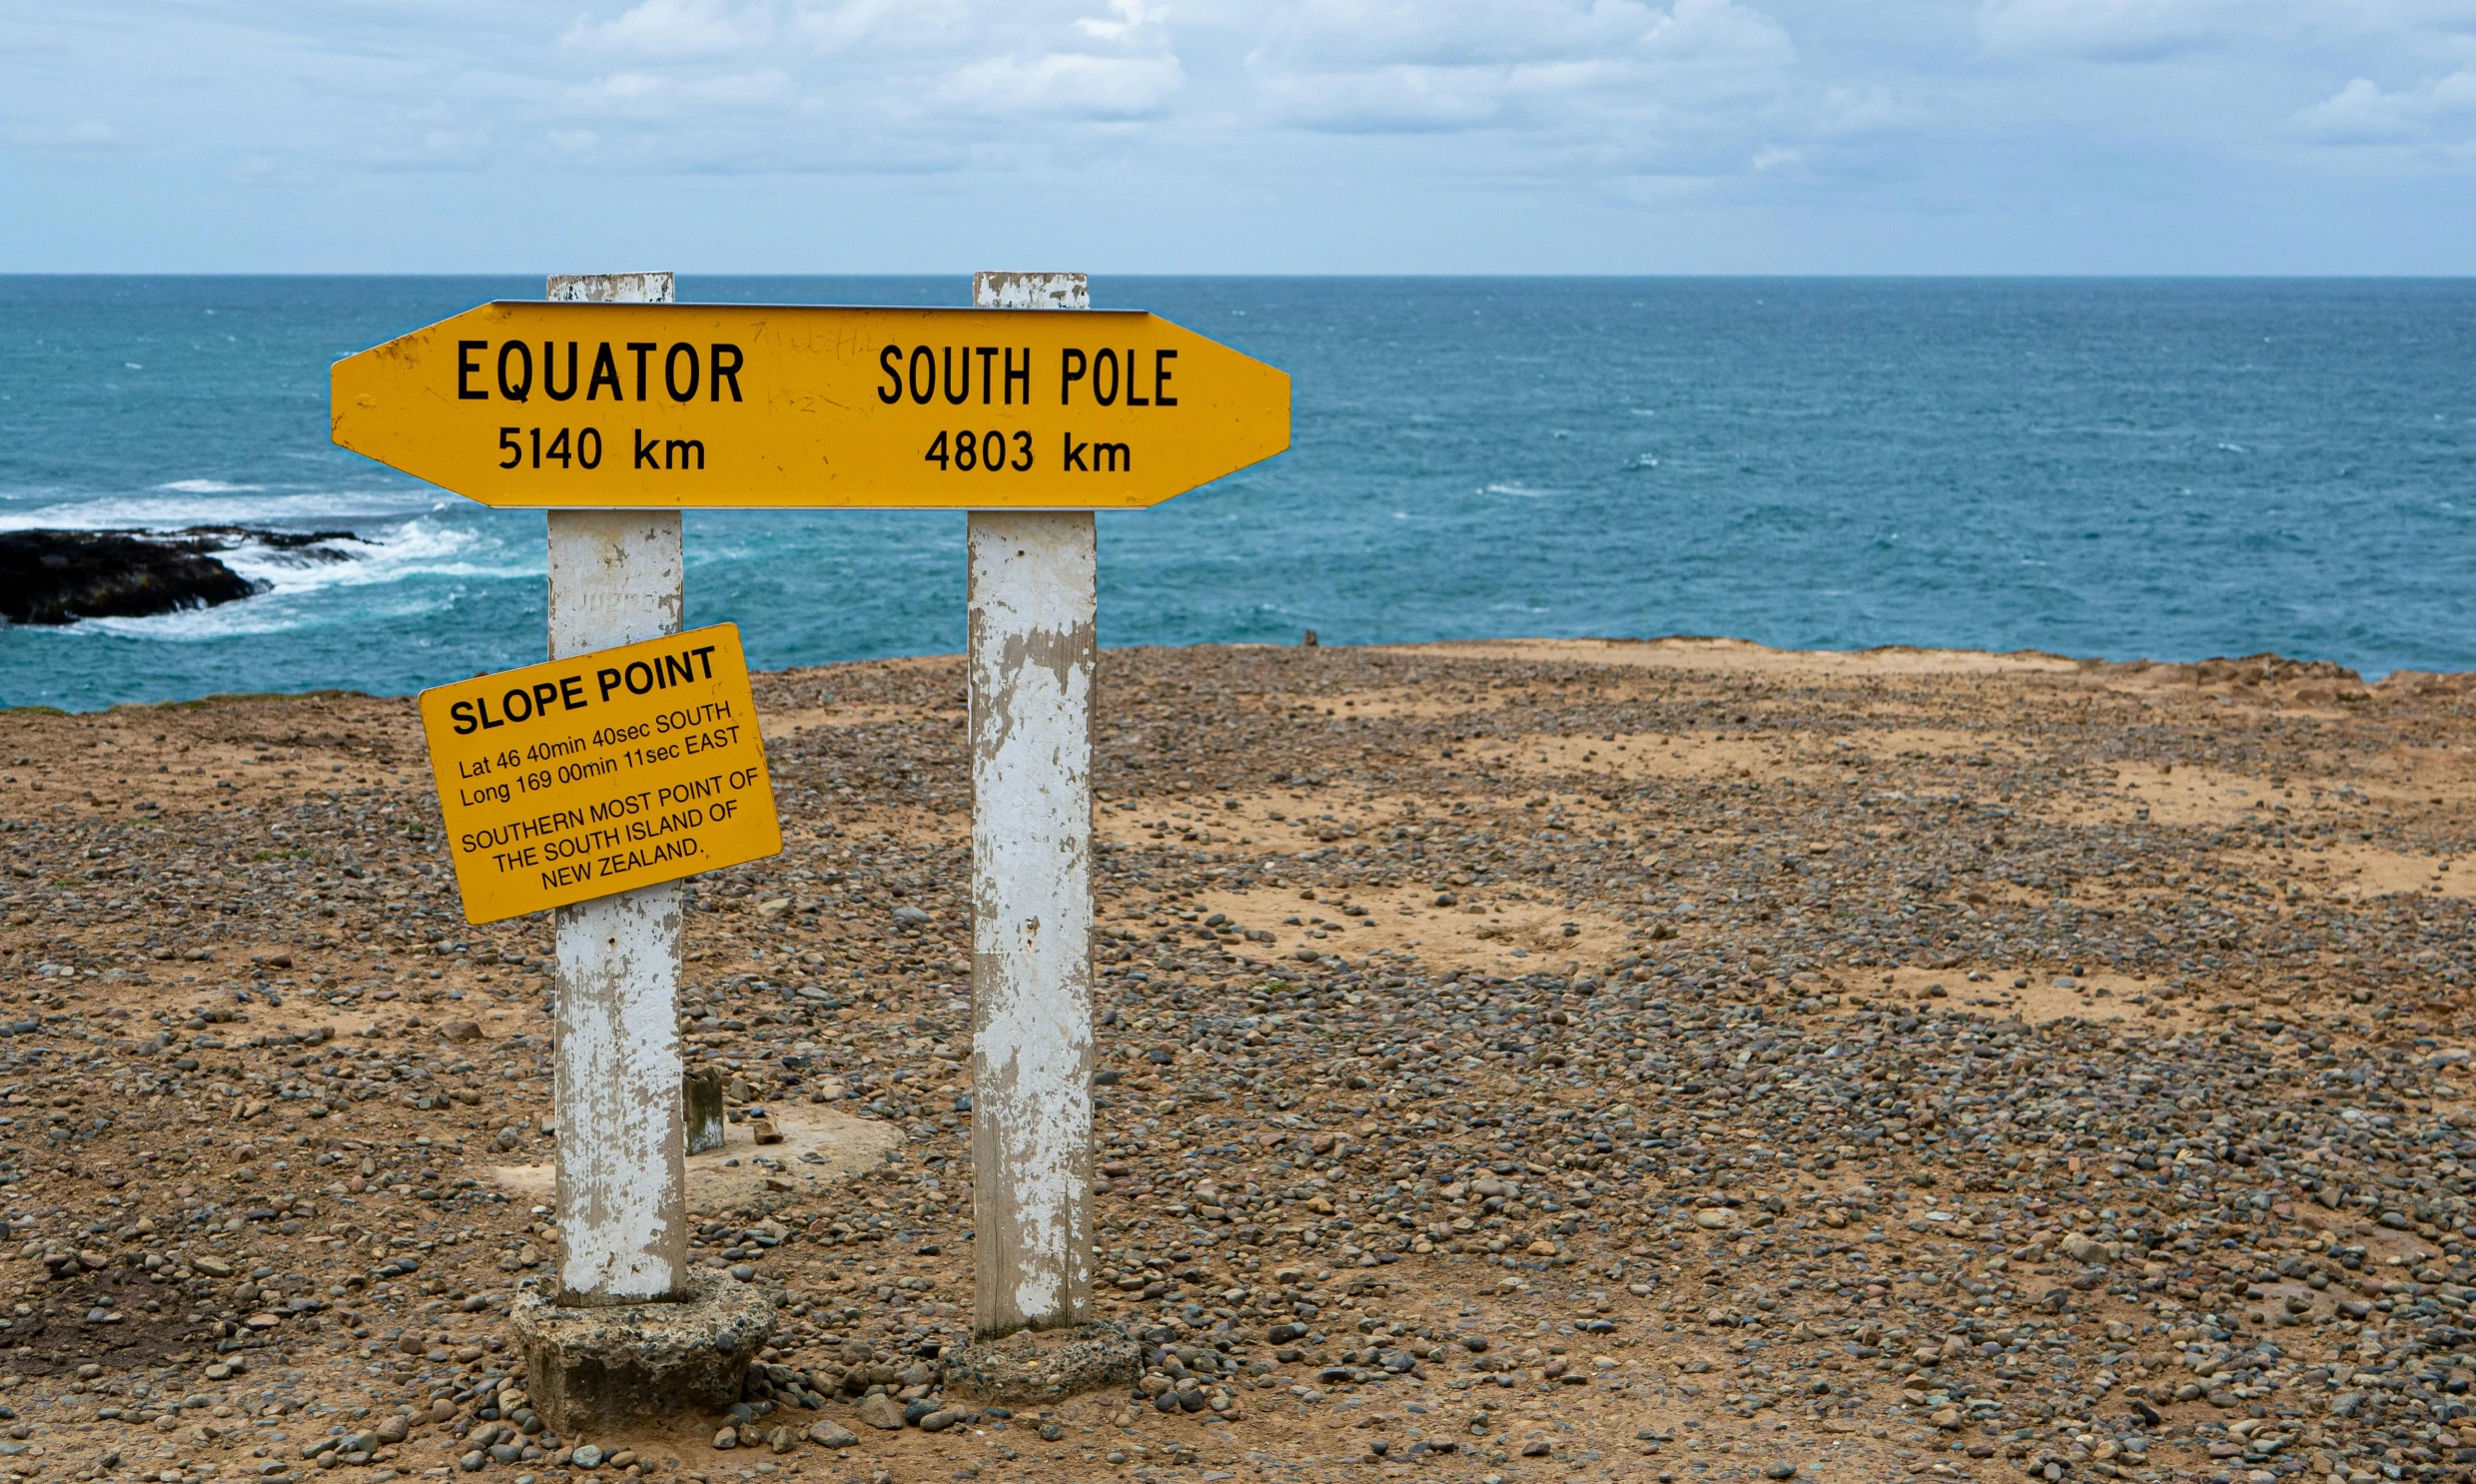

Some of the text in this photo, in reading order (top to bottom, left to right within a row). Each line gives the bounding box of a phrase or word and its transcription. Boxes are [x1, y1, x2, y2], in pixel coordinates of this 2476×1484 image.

[457, 339, 744, 404] EQUATOR
[877, 344, 1031, 405] SOUTH
[1061, 347, 1179, 407] POLE
[498, 426, 705, 470] 5140 km
[924, 429, 1131, 472] 4803 km
[449, 645, 716, 735] SLOPE POINT
[458, 700, 731, 779] Lat 46 40min 40sec SOUTH
[459, 725, 740, 807] Long 169 00min 11sec EAST
[461, 766, 758, 853] SOUTHERN MOST POINT OF
[492, 799, 738, 873] THE SOUTH ISLAND OF
[541, 837, 704, 891] NEW ZEALAND.
